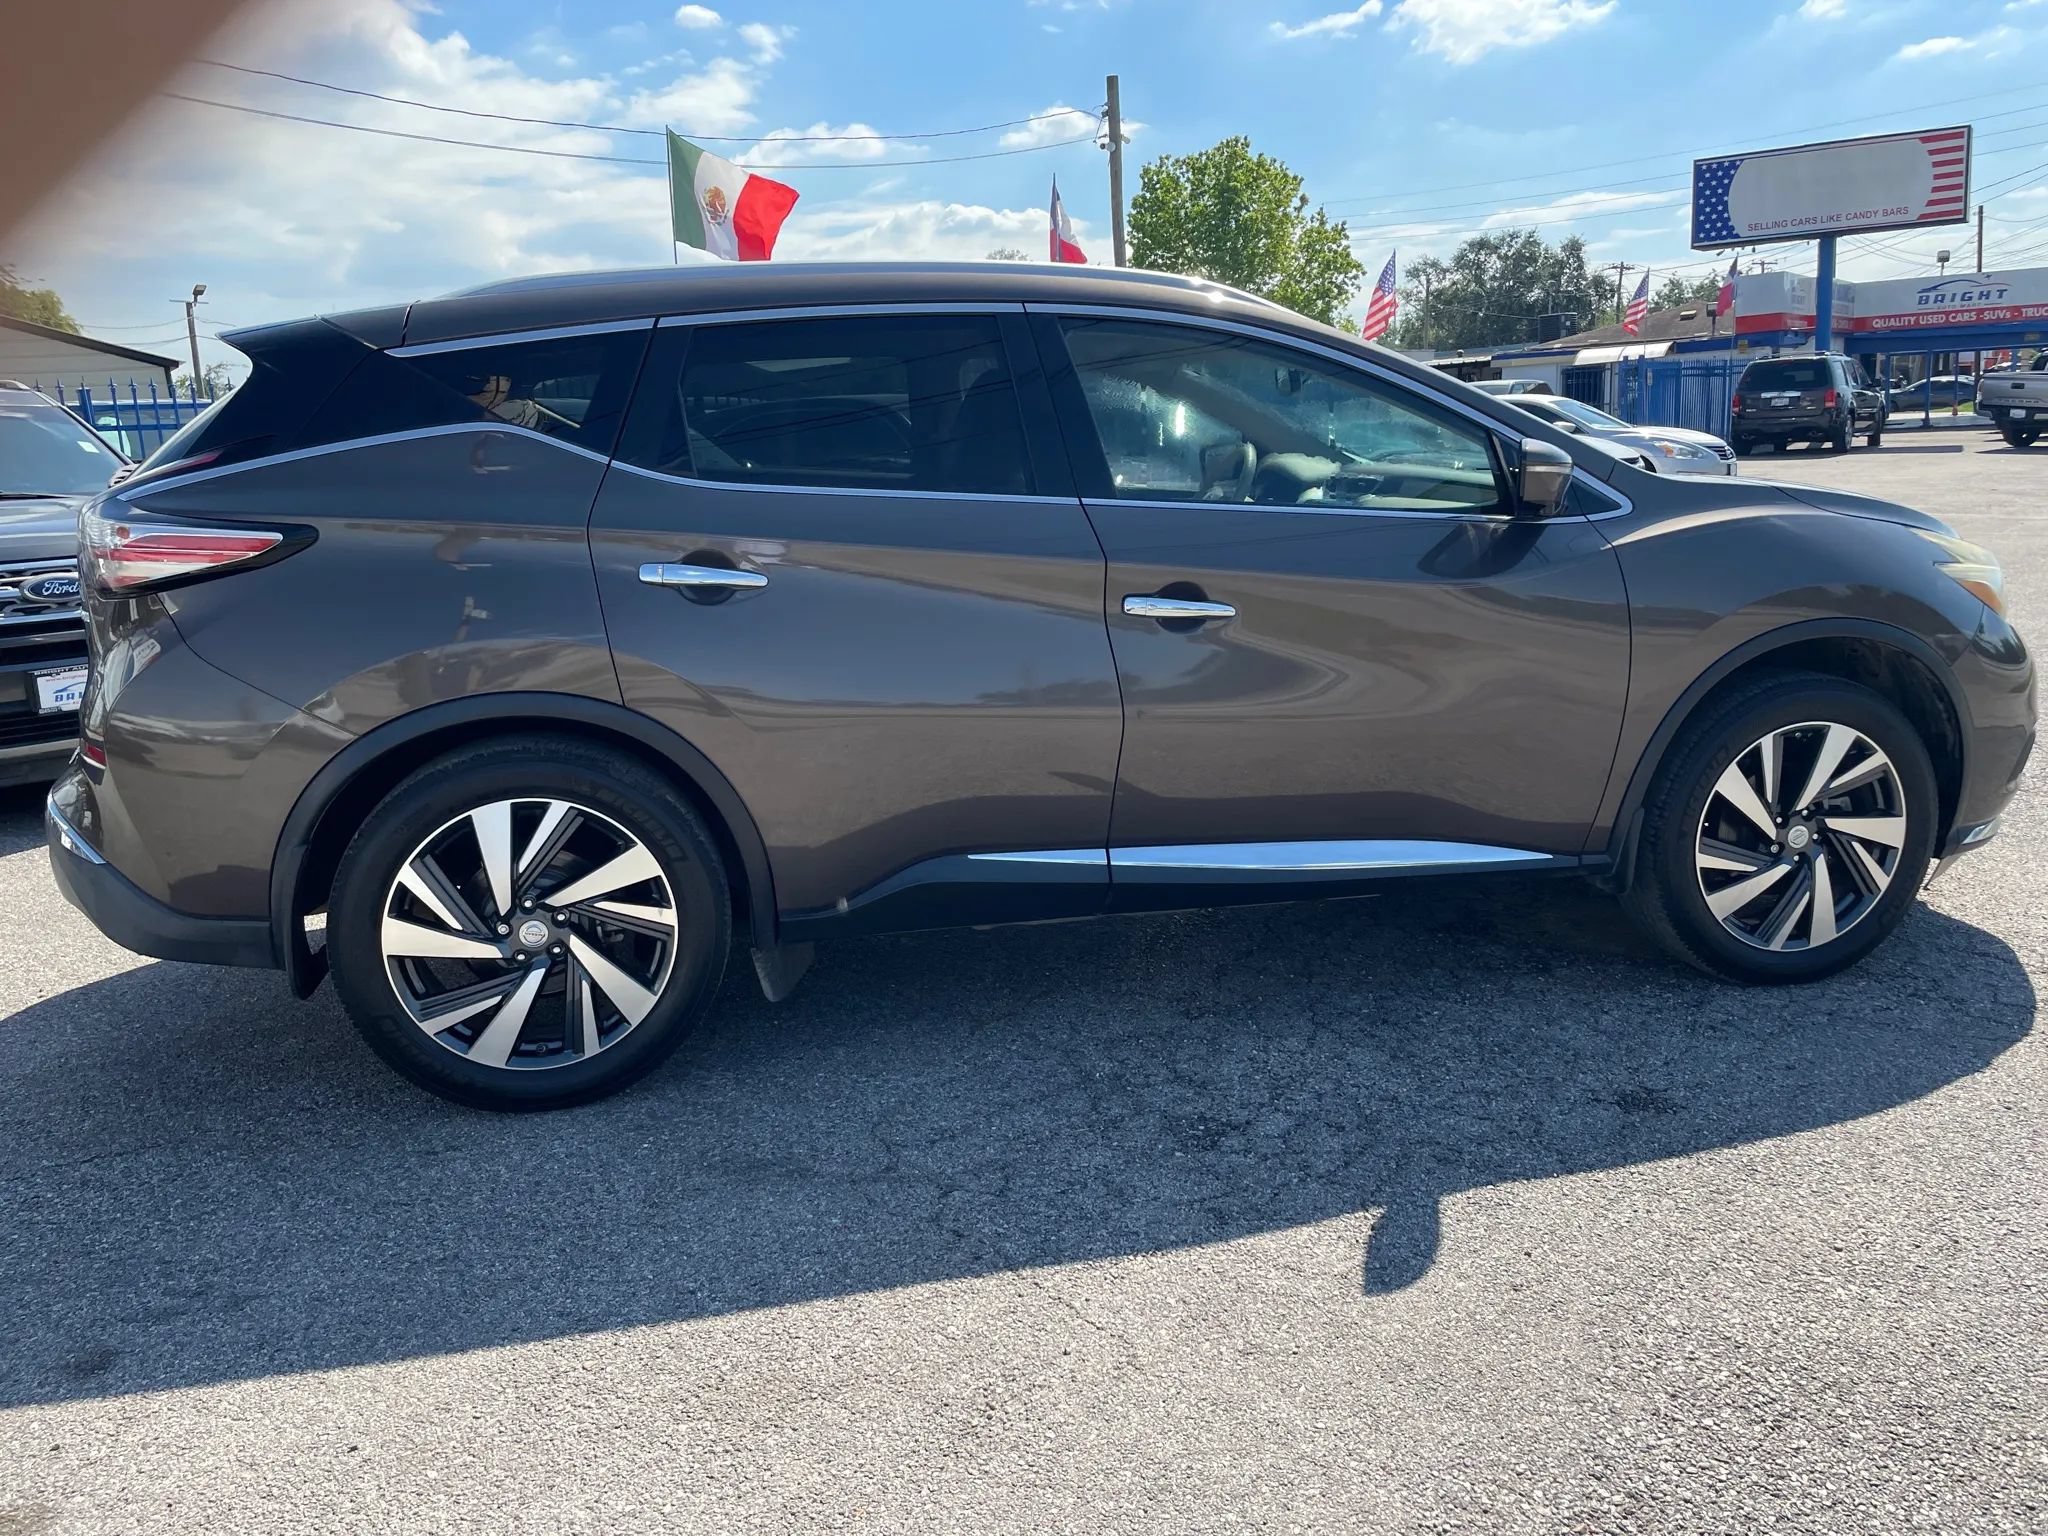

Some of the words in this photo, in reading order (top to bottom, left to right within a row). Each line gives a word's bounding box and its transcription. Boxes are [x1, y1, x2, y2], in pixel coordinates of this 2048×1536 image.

[1747, 219, 1788, 232] SELLING
[1790, 216, 1818, 227] CARS
[1820, 213, 1842, 224] LIKE
[1845, 209, 1879, 221] CANDY
[1882, 206, 1909, 218] BARS
[1917, 289, 2008, 306] BRIGHT
[1872, 315, 1917, 329] QUALITY
[1919, 313, 1945, 325] USED
[1948, 311, 1977, 323] CARS
[42, 579, 80, 596] Ford
